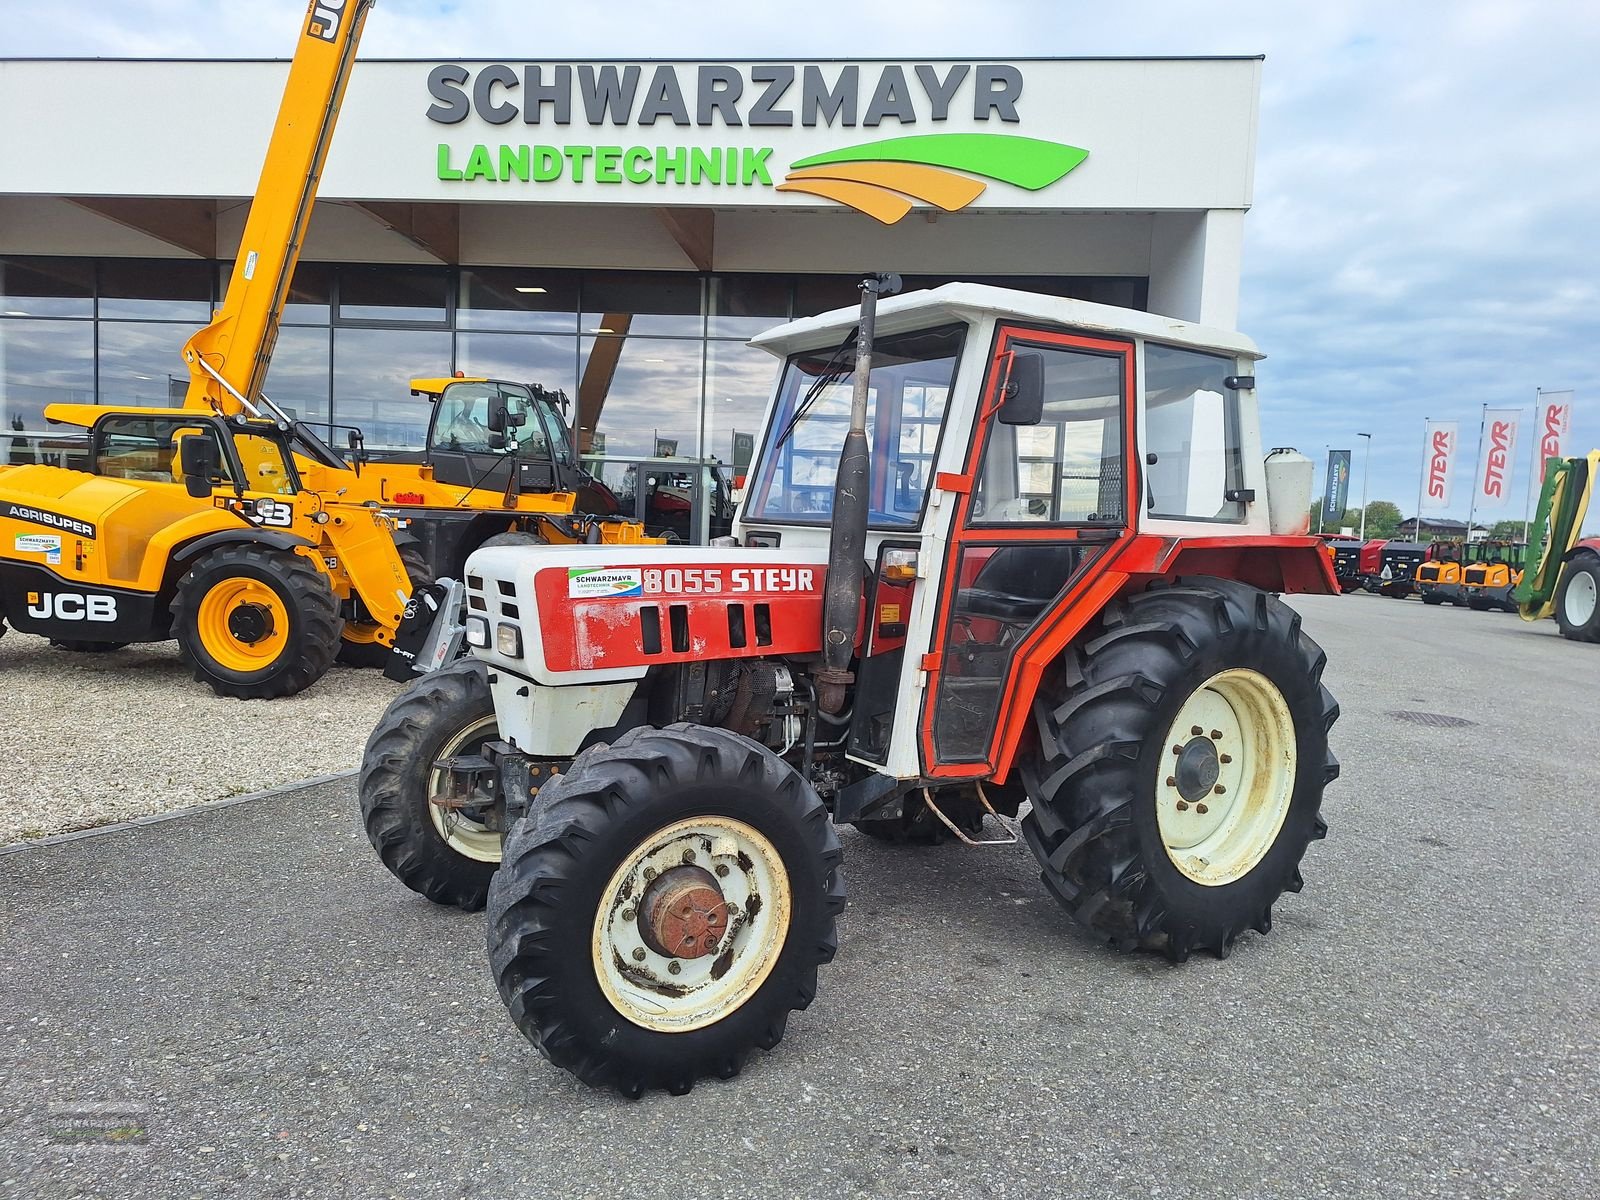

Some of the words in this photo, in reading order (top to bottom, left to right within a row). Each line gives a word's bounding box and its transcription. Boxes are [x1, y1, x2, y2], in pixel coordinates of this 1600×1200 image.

[426, 63, 1023, 127] SCHWARZMAYR
[437, 143, 774, 187] LANDTECHNIK
[1428, 430, 1448, 499] STEYR
[1484, 421, 1509, 498] STEYR
[1540, 404, 1562, 484] EYR
[1329, 464, 1339, 512] SCHWARZMAYR
[9, 506, 93, 536] AGRISUPER
[576, 575, 632, 583] SCHWARZMAYR
[643, 568, 722, 593] 8055
[731, 568, 814, 592] STEYR
[28, 592, 117, 622] JCB
